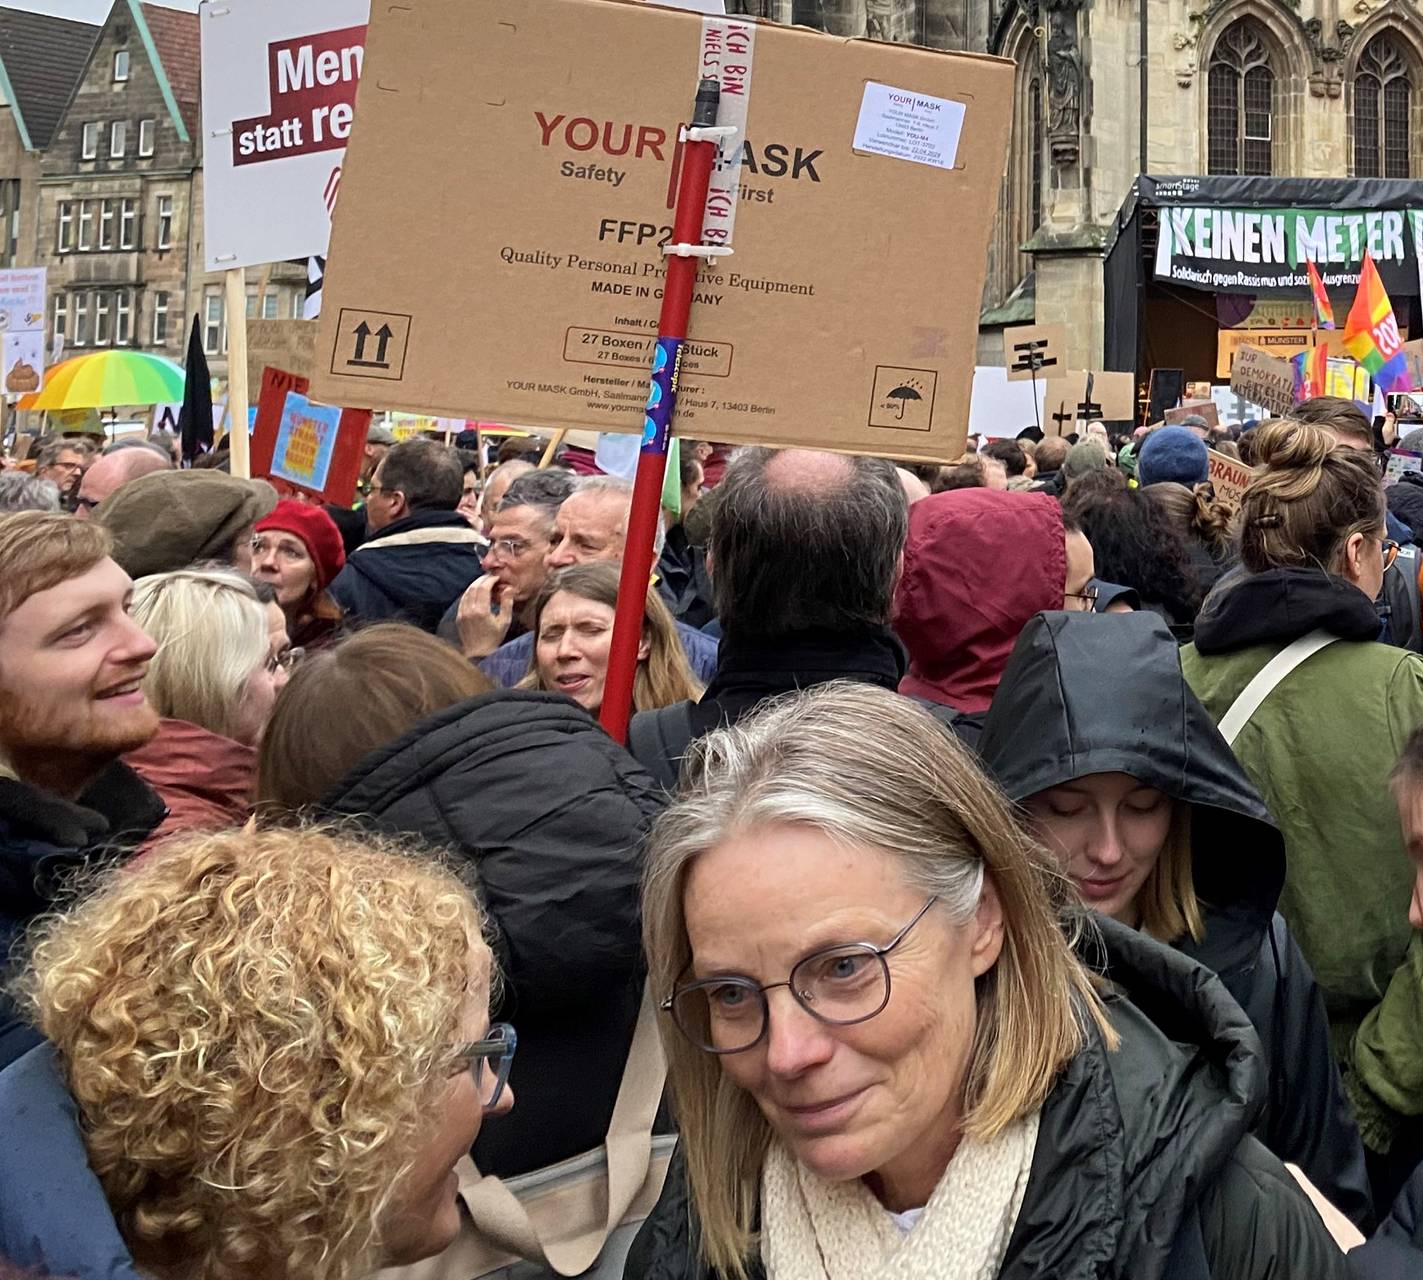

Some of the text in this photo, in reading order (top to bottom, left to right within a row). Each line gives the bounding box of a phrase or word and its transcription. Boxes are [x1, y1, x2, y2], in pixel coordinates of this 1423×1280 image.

[888, 93, 912, 105] YOUR
[916, 99, 941, 112] MASK
[239, 103, 353, 155] statt re
[533, 111, 824, 183] YOUR ASK
[560, 159, 627, 188] Safety
[598, 219, 674, 249] FFP2
[1168, 206, 1285, 265] KEINEN
[1296, 211, 1405, 264] METER
[500, 246, 816, 297] Quality Personal Prtive Equipment
[1172, 265, 1361, 288] Solidarisch gegen Rassismus und sozi Ausgrenzu
[590, 281, 724, 306] MADE IN GANY
[614, 316, 643, 328] Inhalt
[582, 332, 600, 345] 27
[601, 335, 644, 351] Boxen
[682, 343, 720, 359] Stück
[597, 351, 610, 360] 27
[611, 352, 641, 364] Boxes
[506, 380, 536, 392] YOUR
[537, 383, 568, 395] MASK
[685, 398, 709, 410] Haus
[721, 401, 749, 413] 13403
[750, 404, 777, 416] Berlin
[583, 375, 629, 388] Hersteller
[637, 379, 699, 395] Maturer
